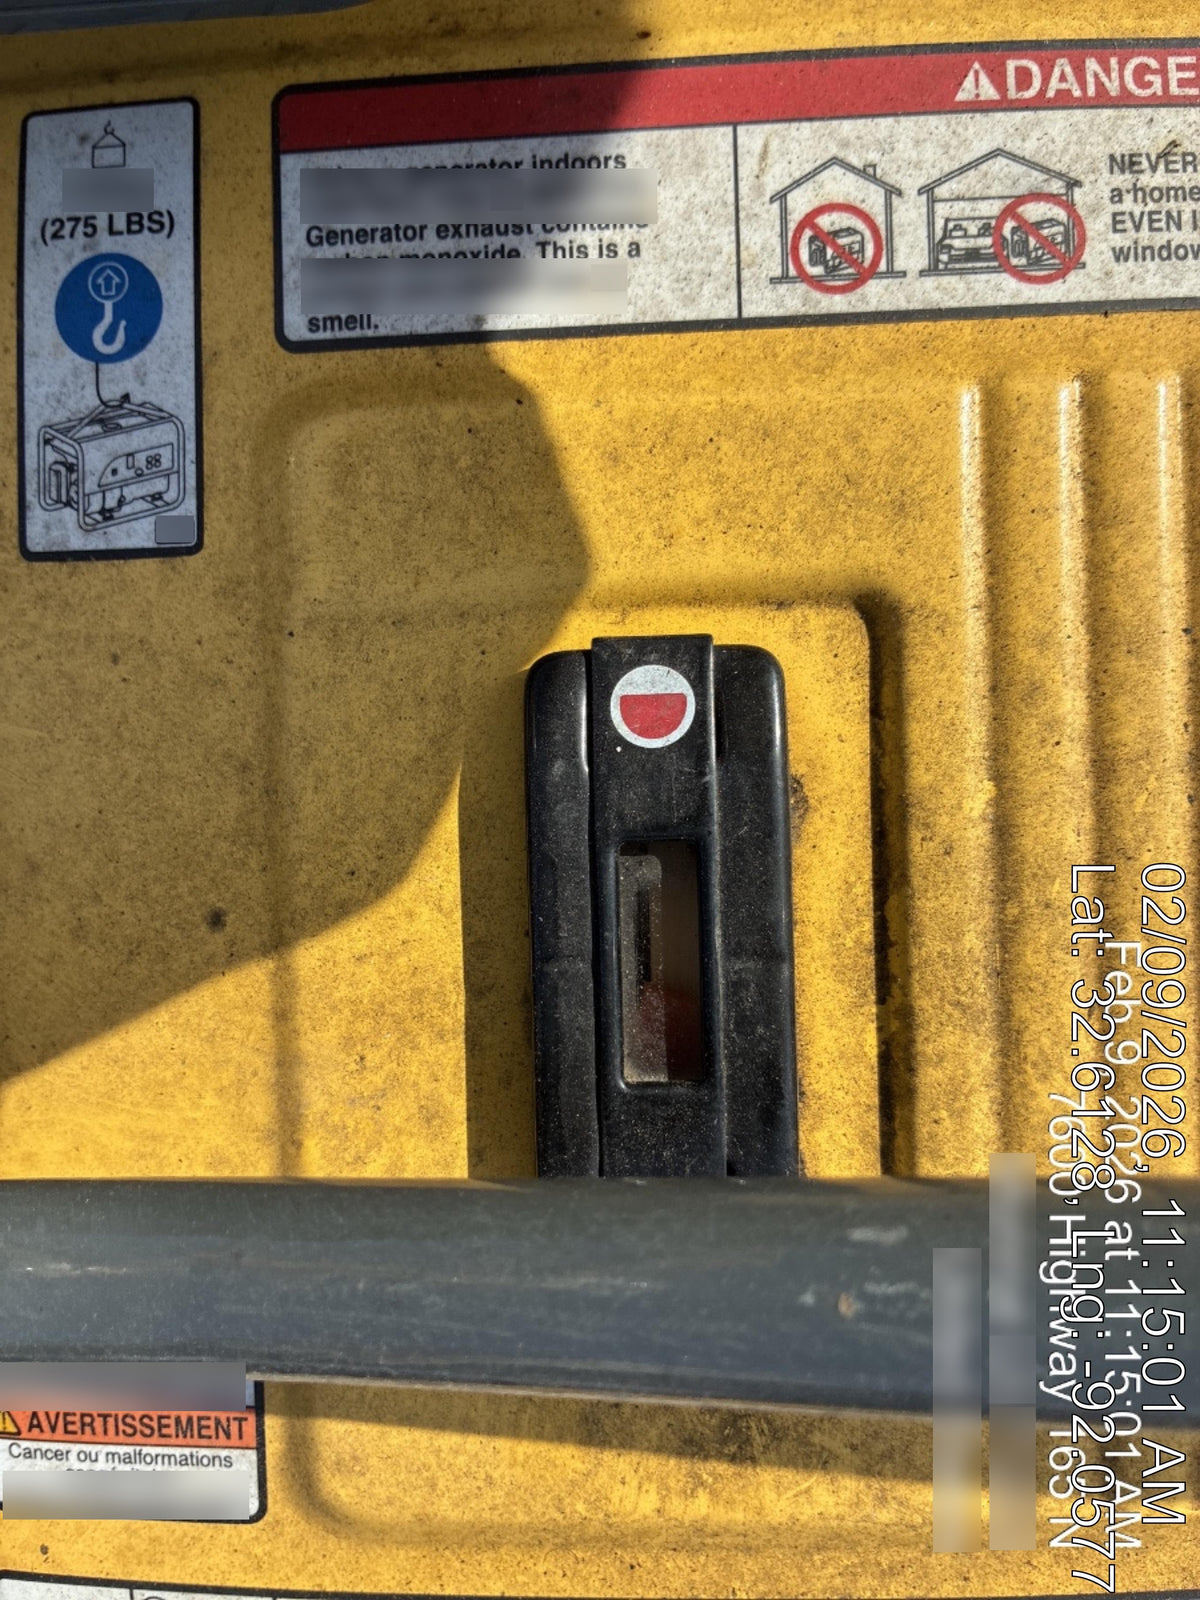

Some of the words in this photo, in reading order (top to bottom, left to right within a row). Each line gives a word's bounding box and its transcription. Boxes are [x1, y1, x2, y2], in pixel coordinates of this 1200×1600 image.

[1108, 151, 1199, 175] NEVER
[1109, 187, 1123, 205] a
[40, 217, 98, 247] (275
[107, 209, 175, 239] LBS)
[1111, 209, 1182, 234] EVEN
[306, 224, 428, 247] Generator
[536, 239, 589, 258] This
[598, 238, 618, 258] is
[628, 240, 641, 258] a
[307, 314, 379, 333] smell.
[27, 1410, 248, 1440] AVERTISSEMENT
[8, 1442, 71, 1462] Cancer
[77, 1448, 98, 1463] ou
[105, 1449, 233, 1469] malformations
